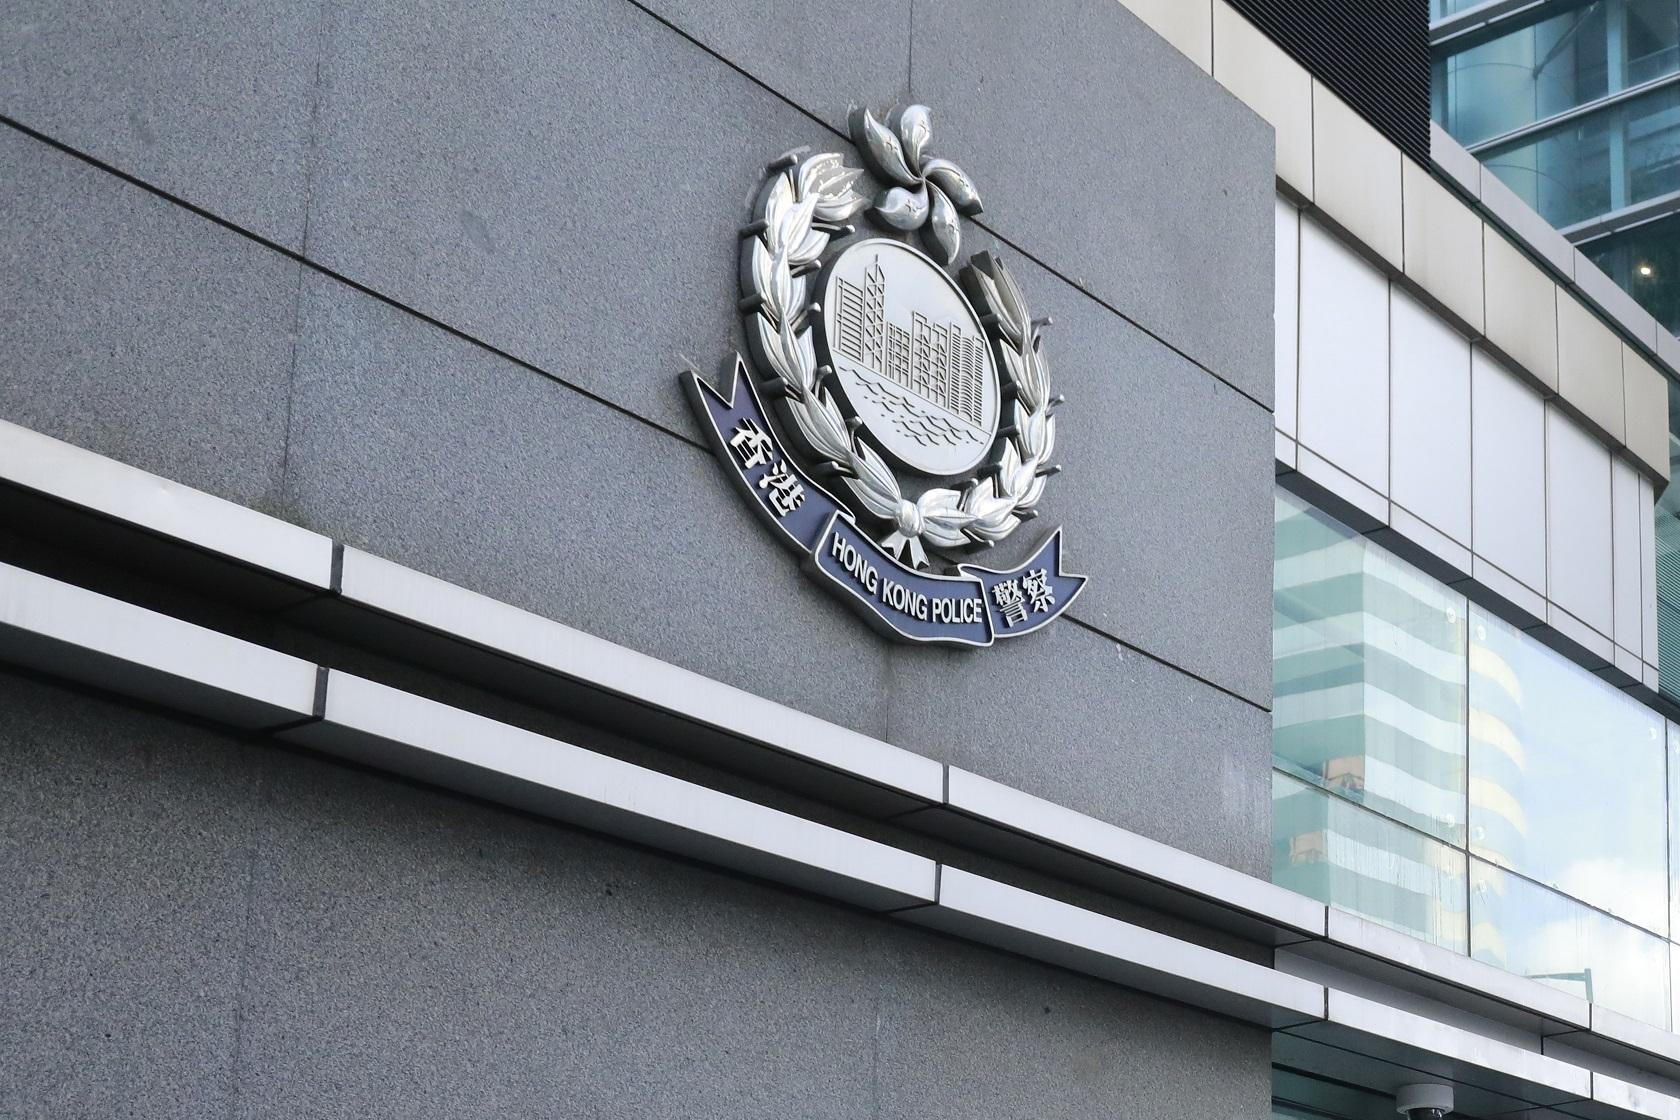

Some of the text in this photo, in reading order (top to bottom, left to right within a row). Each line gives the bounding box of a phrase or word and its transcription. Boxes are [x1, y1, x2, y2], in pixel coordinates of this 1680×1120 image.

[729, 418, 806, 518] 香港
[832, 532, 983, 625] HONG KONG POLICE
[991, 567, 1056, 629] 警察
